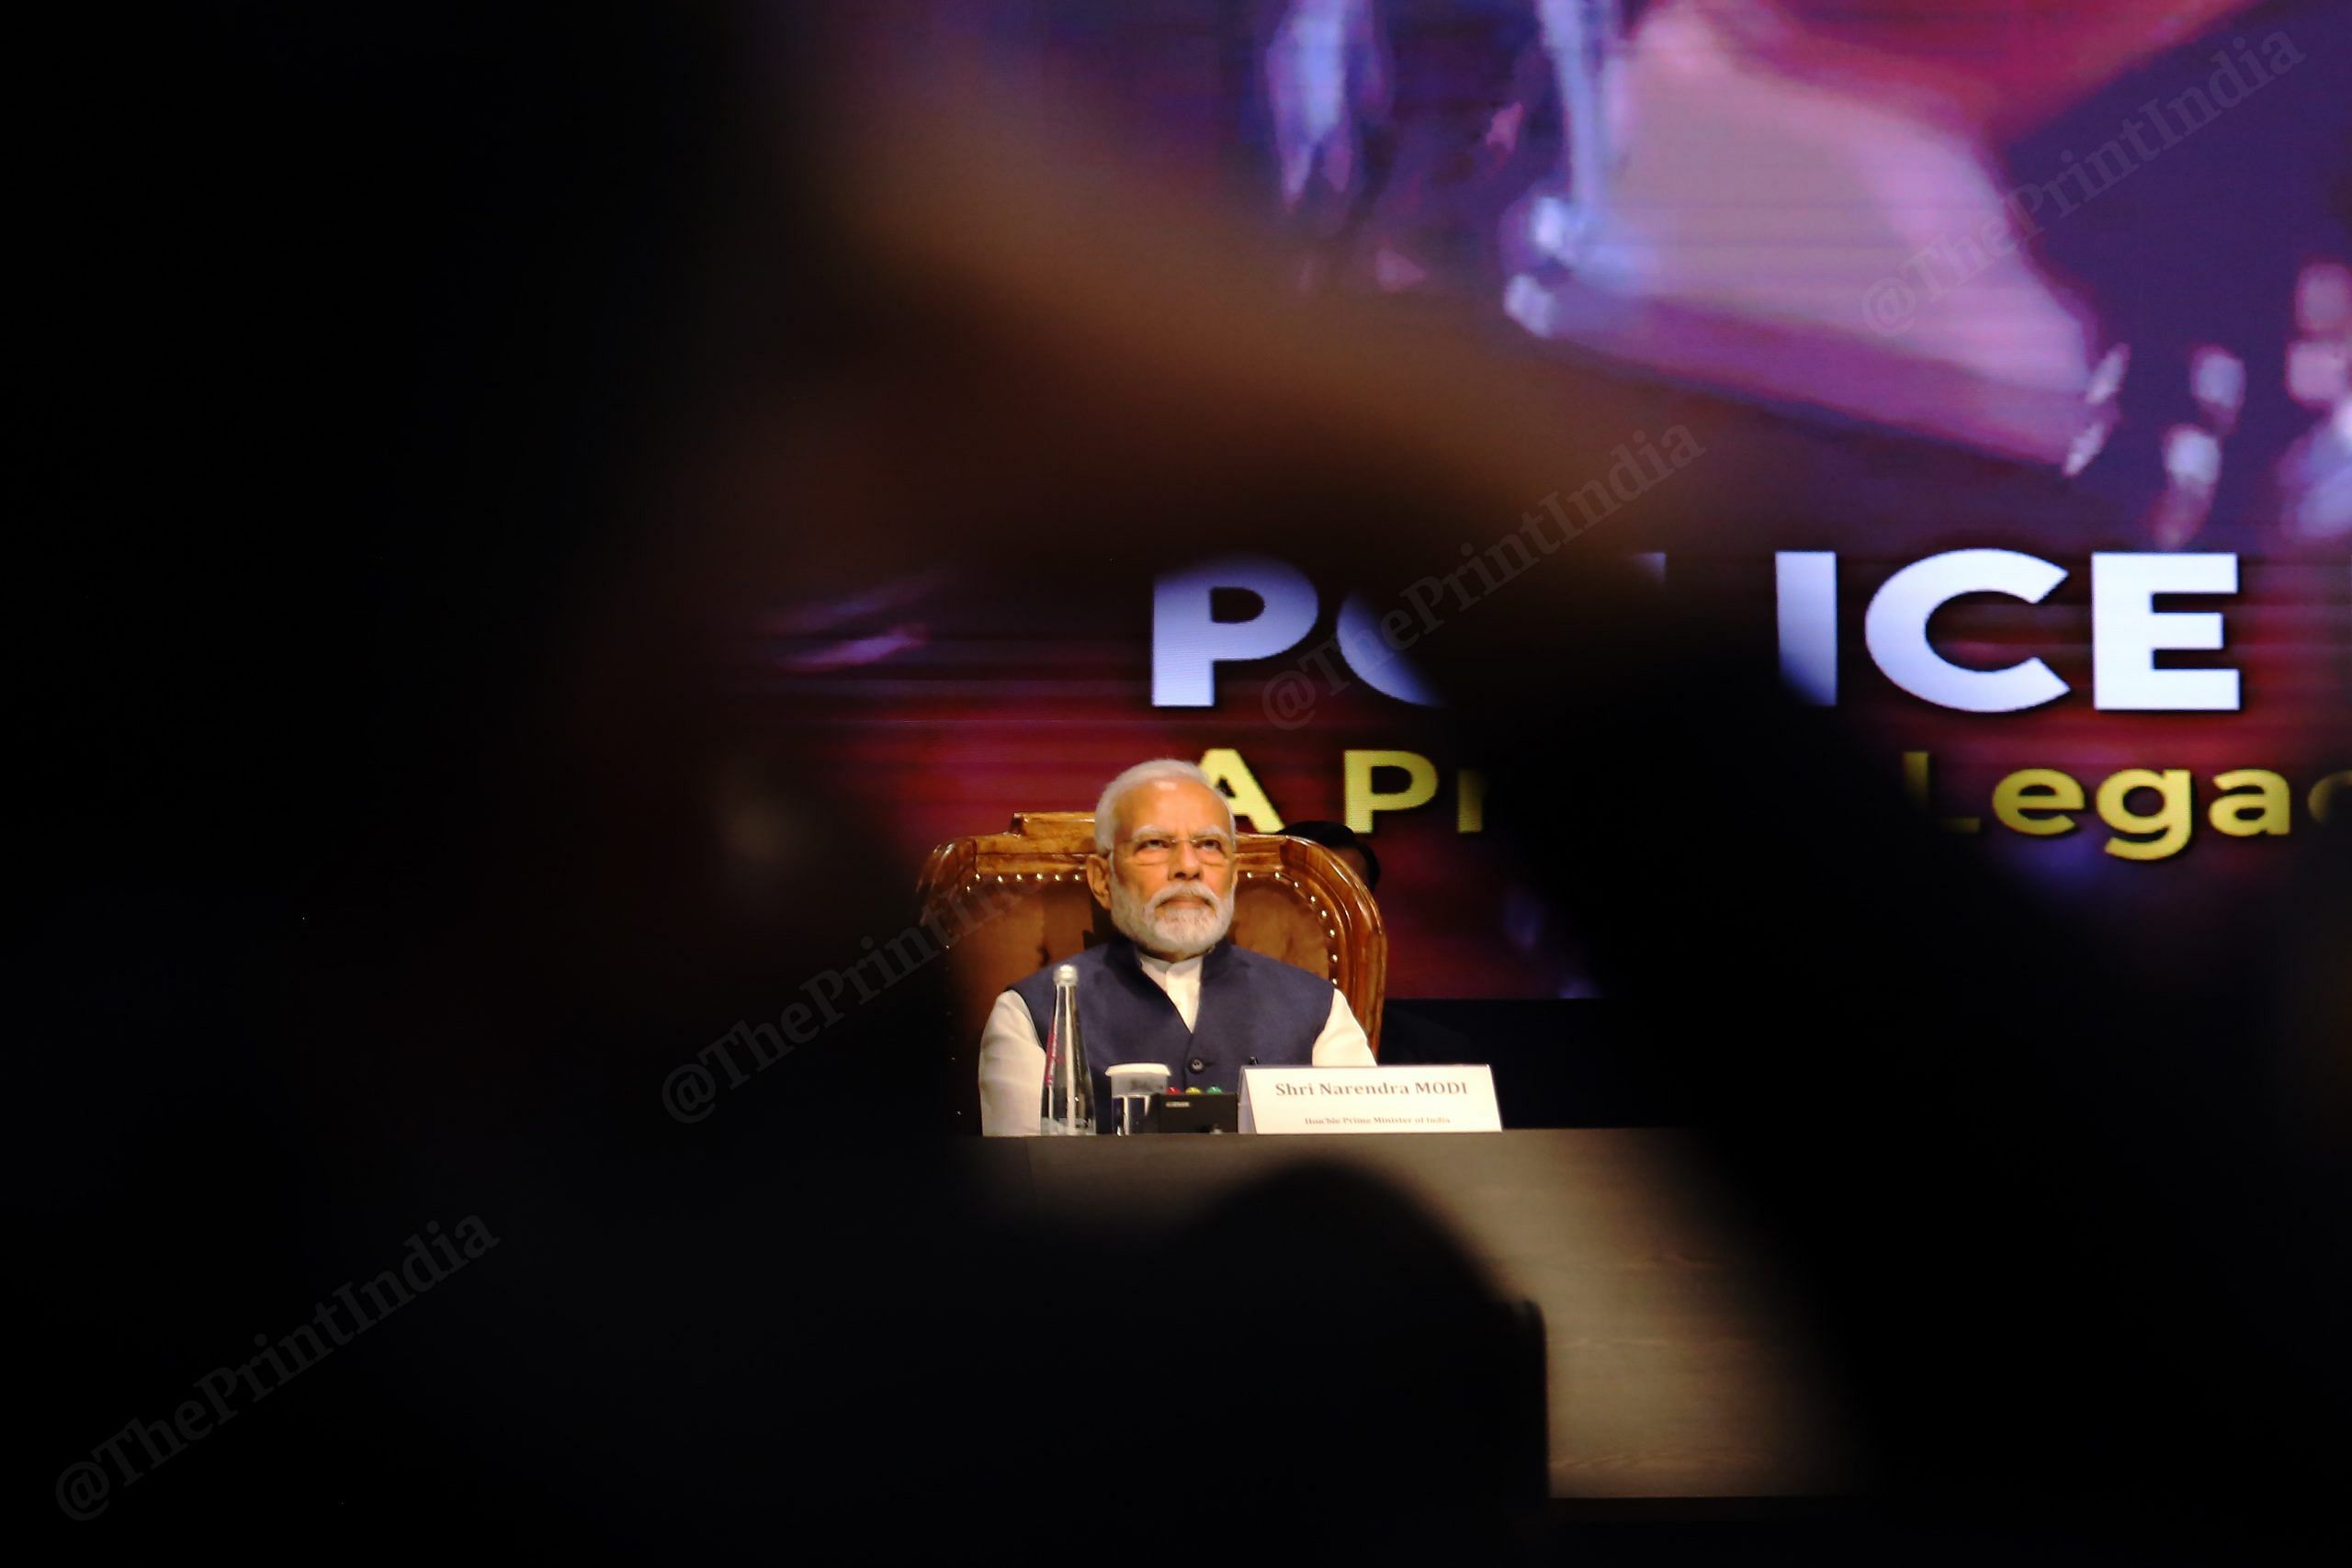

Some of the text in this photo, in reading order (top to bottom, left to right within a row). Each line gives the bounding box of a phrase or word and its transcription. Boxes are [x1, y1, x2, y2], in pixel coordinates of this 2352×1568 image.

[1151, 548, 2241, 713] PICE
[1275, 1081, 1468, 1097] Shri Narendra MODI
[1374, 1116, 1412, 1124] Minister
